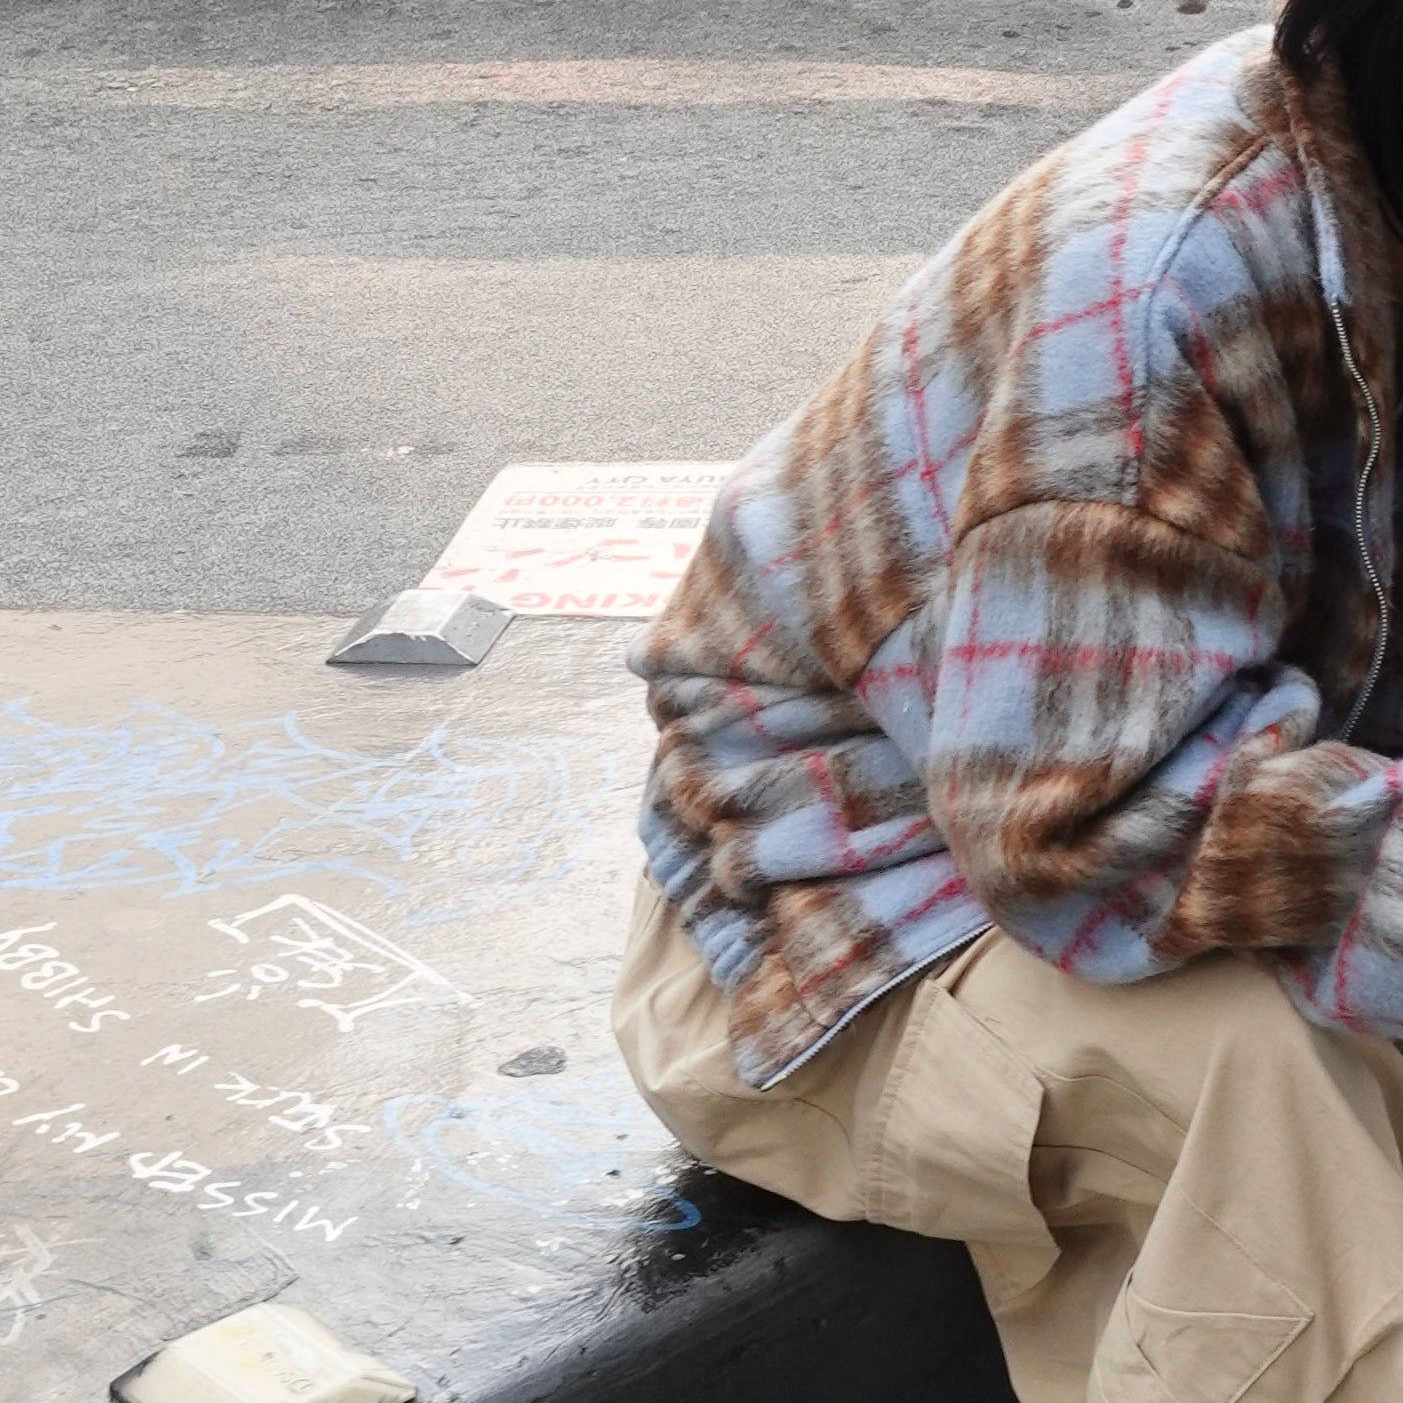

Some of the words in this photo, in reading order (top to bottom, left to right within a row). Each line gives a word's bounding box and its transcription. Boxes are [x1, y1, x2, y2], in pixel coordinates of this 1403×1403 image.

[586, 474, 649, 485] CITY
[636, 516, 709, 531] 園等
[510, 591, 670, 610] KING
[139, 1043, 211, 1076] IN
[11, 1102, 122, 1154] MY
